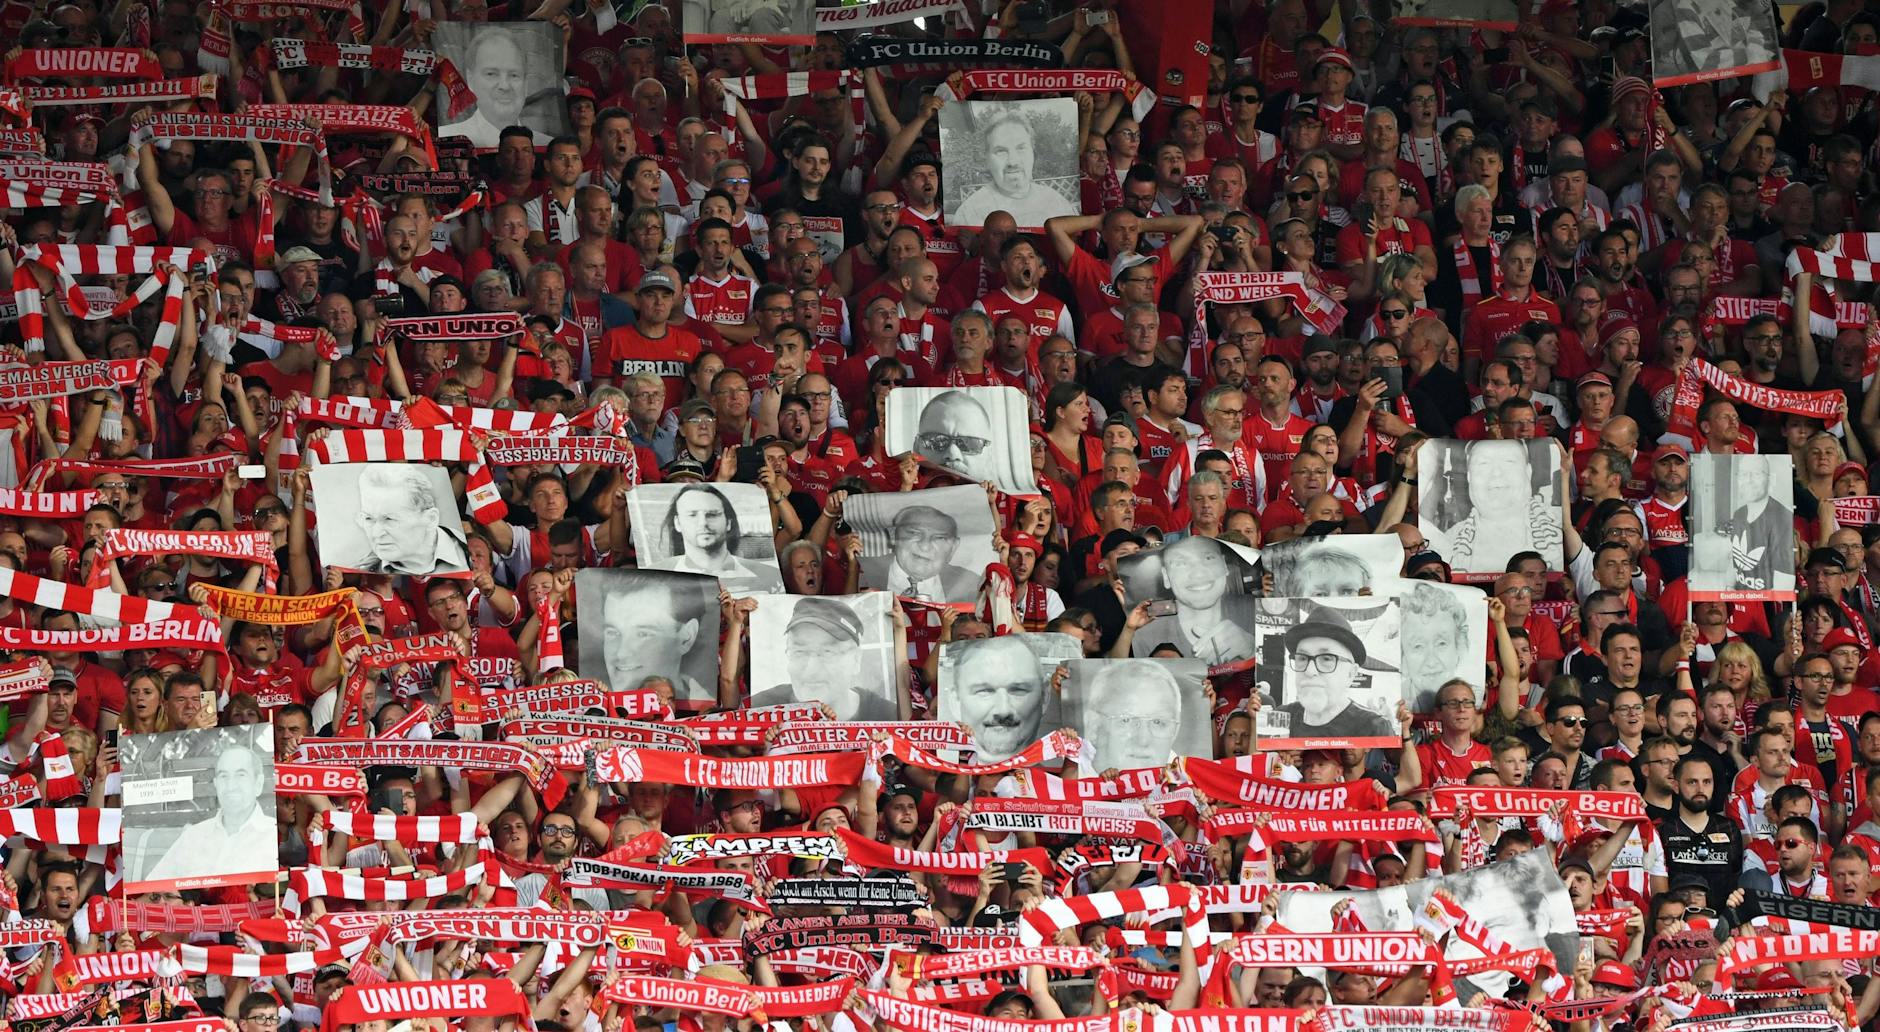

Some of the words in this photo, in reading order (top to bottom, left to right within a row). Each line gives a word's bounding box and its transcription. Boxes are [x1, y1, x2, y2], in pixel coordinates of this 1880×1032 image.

[871, 46, 901, 61] FC
[908, 42, 979, 57] Union
[984, 42, 1053, 62] Berlin
[34, 50, 141, 74] UNIONER
[988, 71, 1009, 87] FC
[1014, 70, 1067, 86] Union
[1072, 70, 1128, 89] Berlin
[152, 126, 248, 141] EISERN
[13, 166, 81, 180] Union
[1211, 273, 1237, 285] WIE
[1238, 286, 1282, 299] WEISS
[621, 360, 686, 378] BERLIN
[1720, 592, 1744, 600] Endlich
[258, 598, 284, 613] AN
[225, 609, 246, 621] FÜR
[246, 611, 282, 623] EISERN
[1255, 614, 1293, 626] SPATEN
[30, 626, 121, 644] UNION
[128, 620, 223, 644] BERLIN
[521, 722, 559, 735] FC
[566, 723, 643, 743] Union
[796, 743, 830, 752] IMMER
[1304, 739, 1329, 747] Endlich
[307, 742, 522, 766] AUSWÄRTSAUFSTEIGER
[684, 758, 697, 784] 1.
[698, 758, 718, 787] FC
[720, 759, 770, 787] UNION
[773, 758, 829, 787] BERLIN
[1239, 779, 1349, 812] UNIONER
[994, 814, 1045, 829] BLEIBT
[1083, 817, 1137, 835] WEISS
[1269, 817, 1297, 832] NUR
[1300, 817, 1328, 832] FÜR
[175, 878, 202, 888] Endlich
[710, 874, 744, 889] 1968
[838, 887, 858, 900] wenn
[870, 885, 890, 900] keine
[766, 915, 834, 933] KAMEN
[873, 913, 909, 926] DER
[1758, 900, 1877, 929] EISERN
[635, 938, 663, 953] UNION
[790, 929, 871, 947] Union
[1230, 938, 1324, 963] EISERN
[1332, 937, 1427, 963] UNION
[73, 951, 161, 981] UNION
[357, 983, 488, 1015] UNIONER
[642, 980, 700, 1004] Union
[1363, 1007, 1424, 1028] UNION
